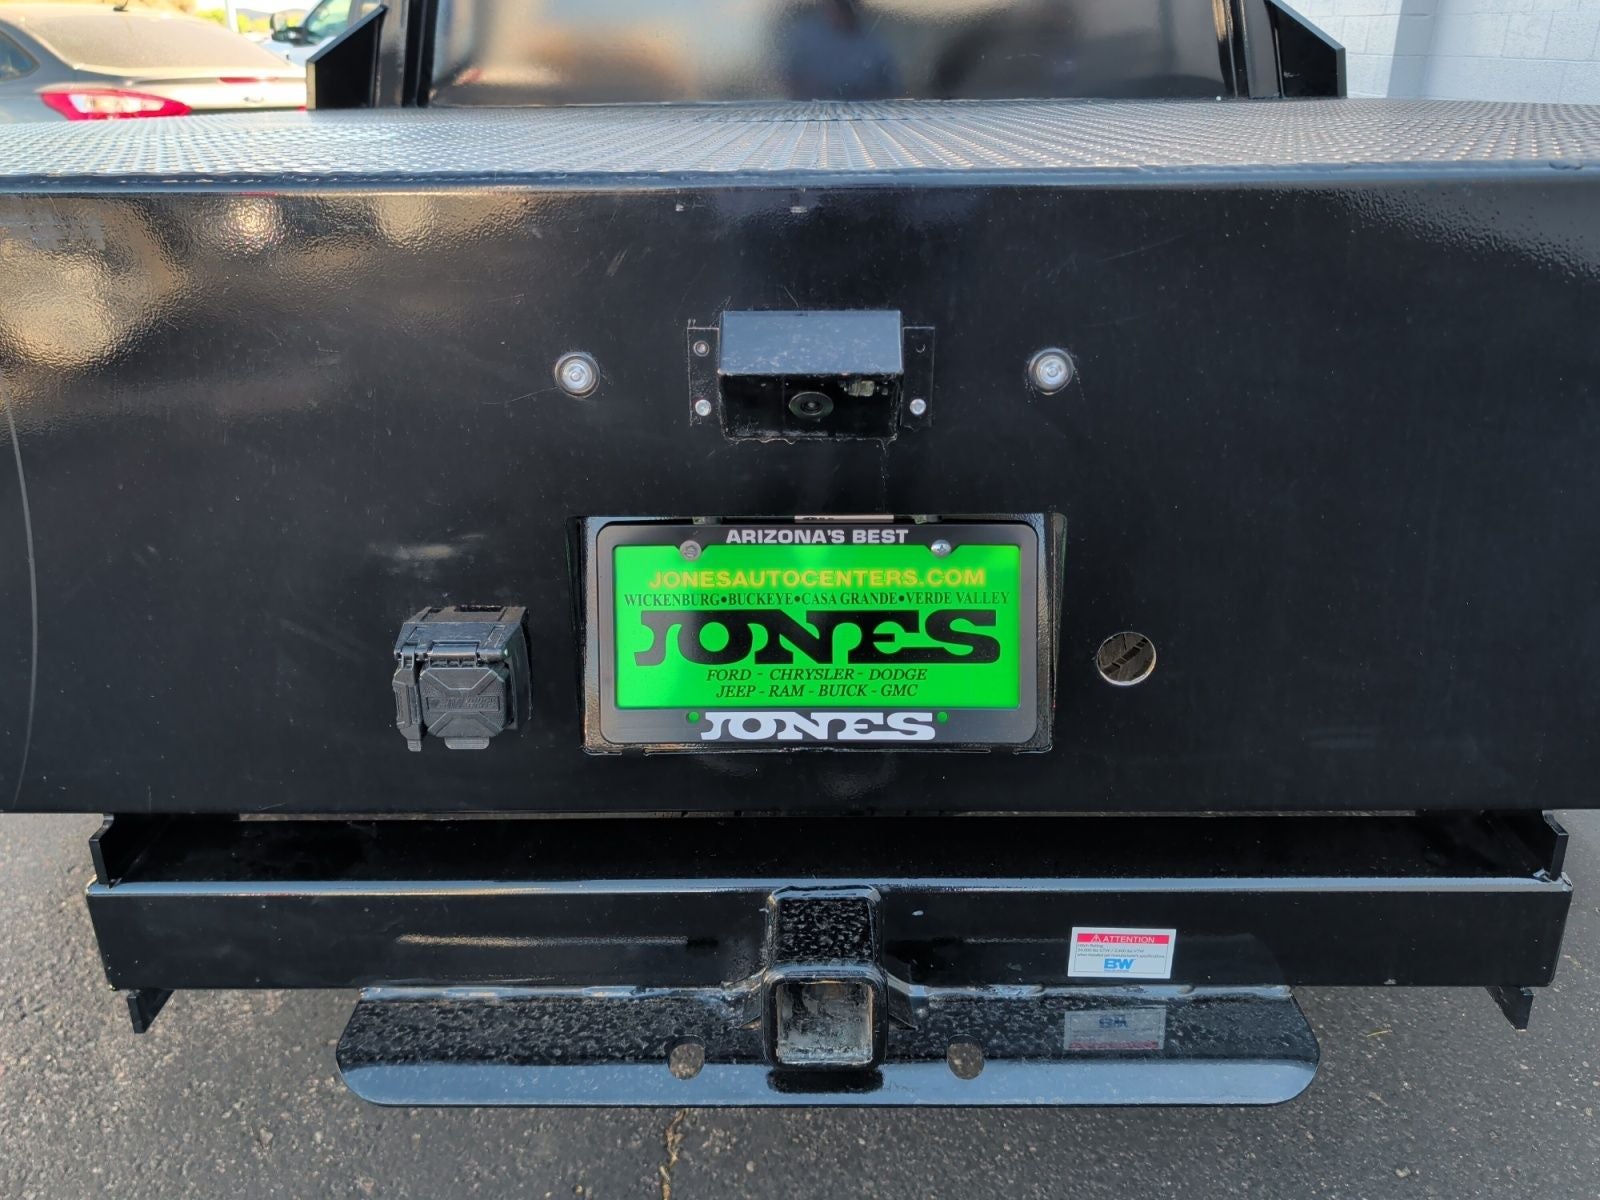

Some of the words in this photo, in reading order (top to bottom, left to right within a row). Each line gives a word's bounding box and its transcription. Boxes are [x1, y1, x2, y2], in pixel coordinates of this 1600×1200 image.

[726, 529, 846, 544] ARIZONA'S
[852, 529, 909, 544] BEST
[649, 568, 986, 589] JONESAUTOCENTERS.COM
[956, 591, 1010, 605] VALLEY
[634, 609, 1001, 666] JONES
[707, 669, 752, 682] FORD
[769, 668, 855, 681] CHRYSLER
[868, 668, 928, 681] DODGE
[716, 685, 757, 698] JEEP
[768, 685, 805, 697] RAM
[818, 684, 869, 697] BUICK
[880, 684, 918, 697] GMC
[700, 711, 936, 741] JONES
